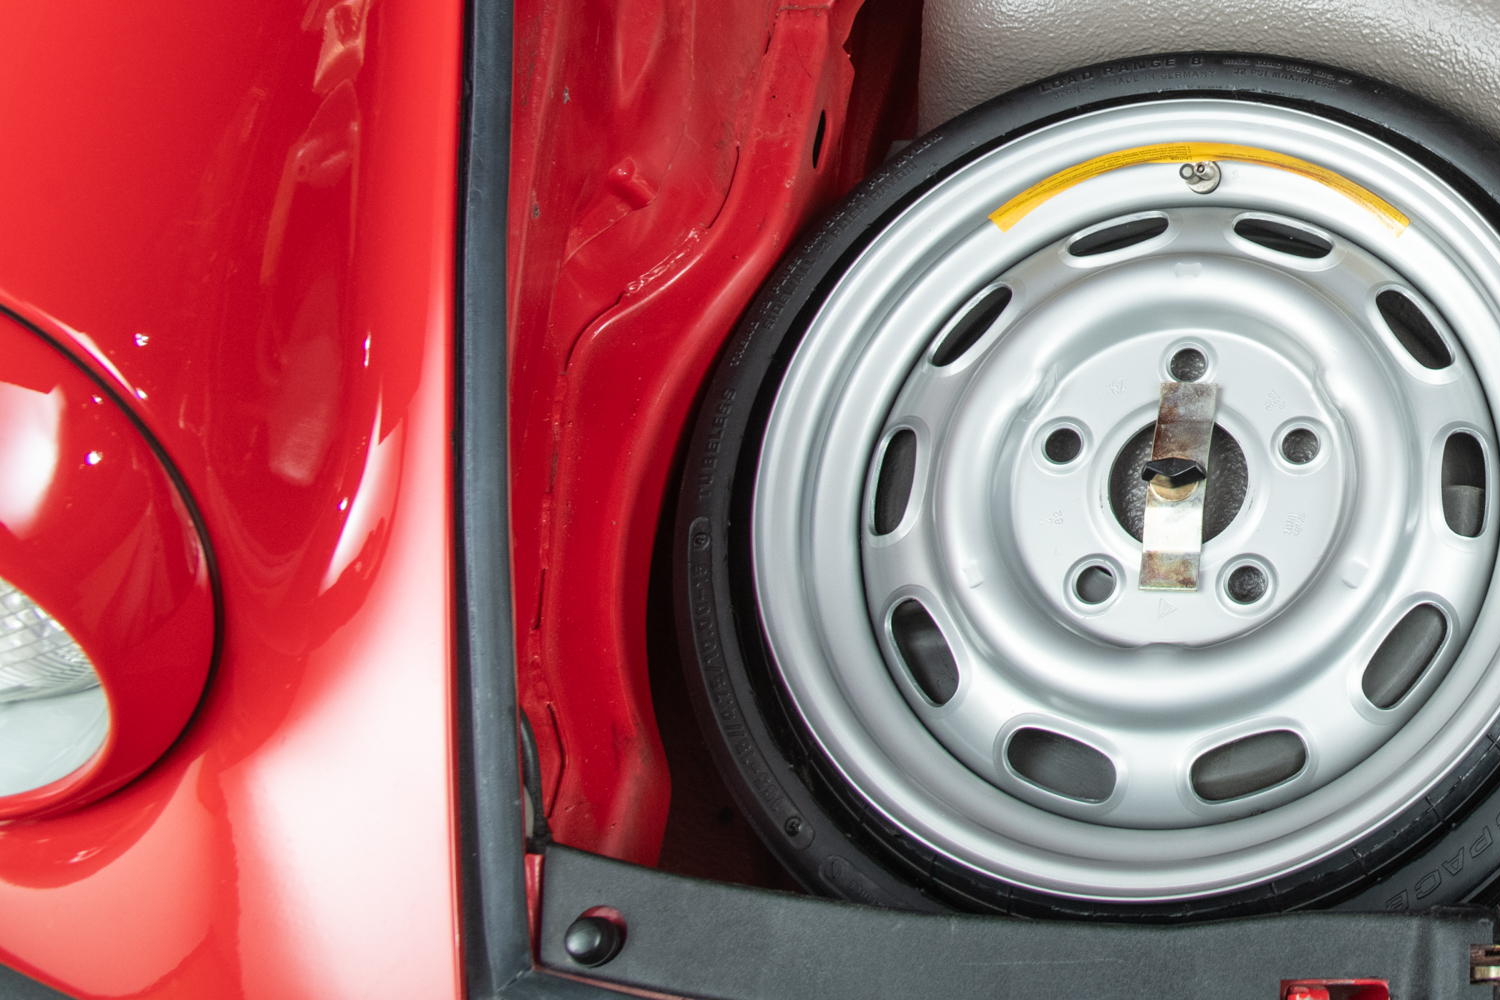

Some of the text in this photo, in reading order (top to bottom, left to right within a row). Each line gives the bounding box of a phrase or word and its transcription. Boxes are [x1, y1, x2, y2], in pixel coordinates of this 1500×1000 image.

[1038, 56, 1202, 93] LOAD RANGE B
[1160, 70, 1215, 79] GERMANY
[698, 386, 736, 500] TUBELESS
